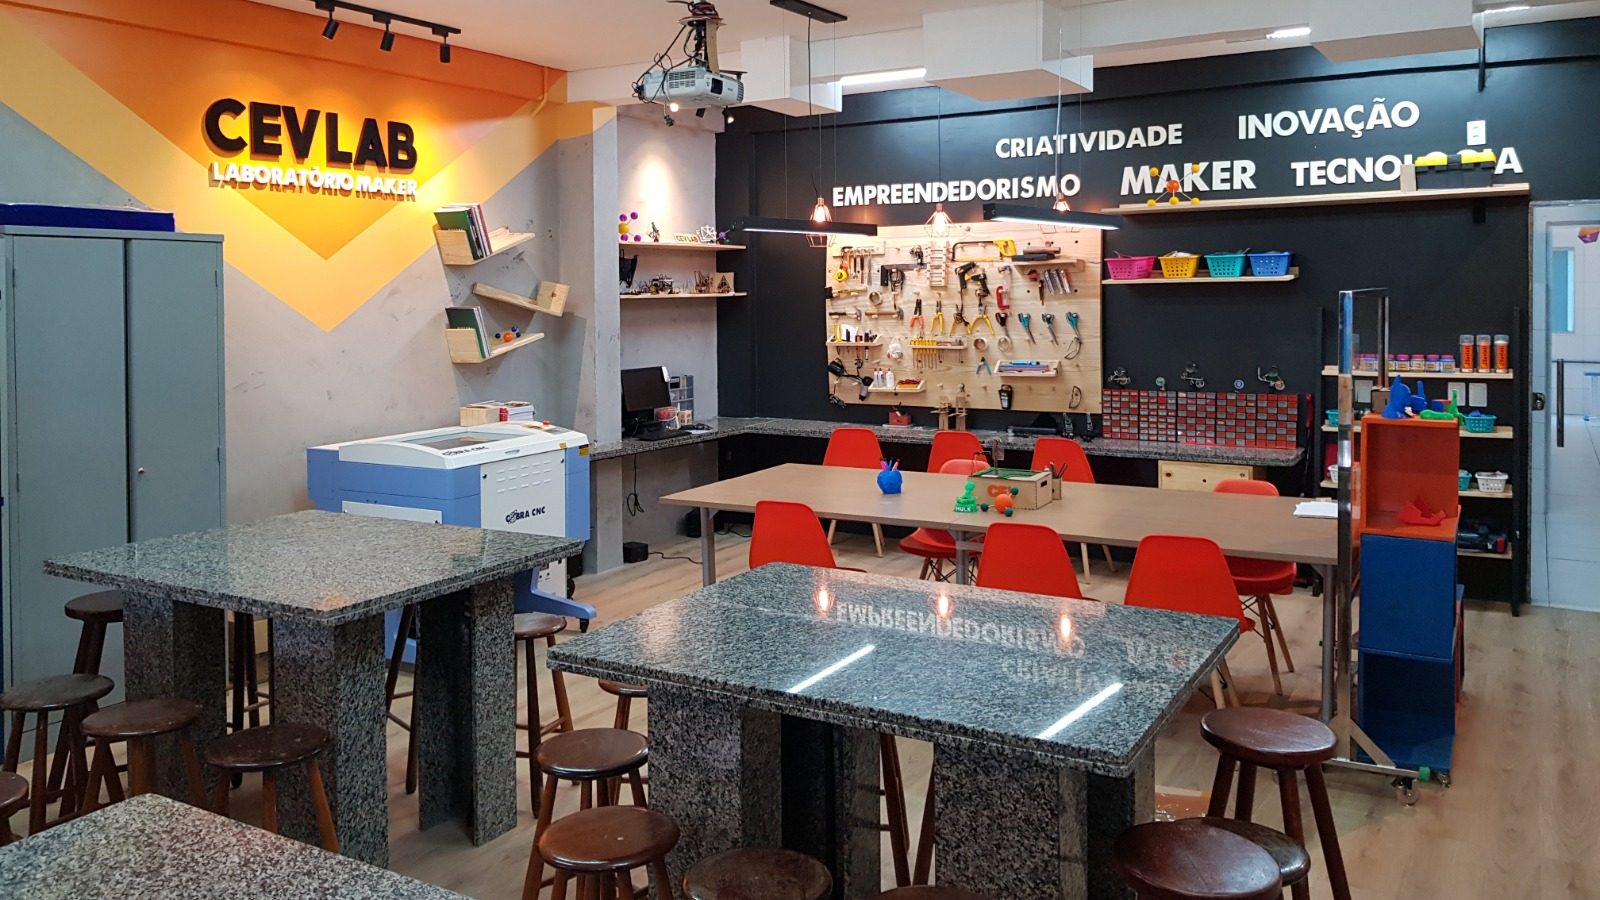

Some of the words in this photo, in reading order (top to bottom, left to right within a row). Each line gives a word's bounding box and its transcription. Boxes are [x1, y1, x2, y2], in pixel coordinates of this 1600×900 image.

[202, 98, 418, 170] CEVLAB
[1238, 97, 1420, 140] INOVAÇÃO
[995, 123, 1183, 159] CRIATIVIDADE
[210, 161, 354, 193] LABORATÓRIO
[356, 174, 418, 196] MAKER
[1120, 159, 1256, 196] MAKER
[1290, 146, 1524, 187] TECNOA
[832, 174, 1081, 207] EMPREENDEDORISMO
[531, 506, 546, 517] CNC
